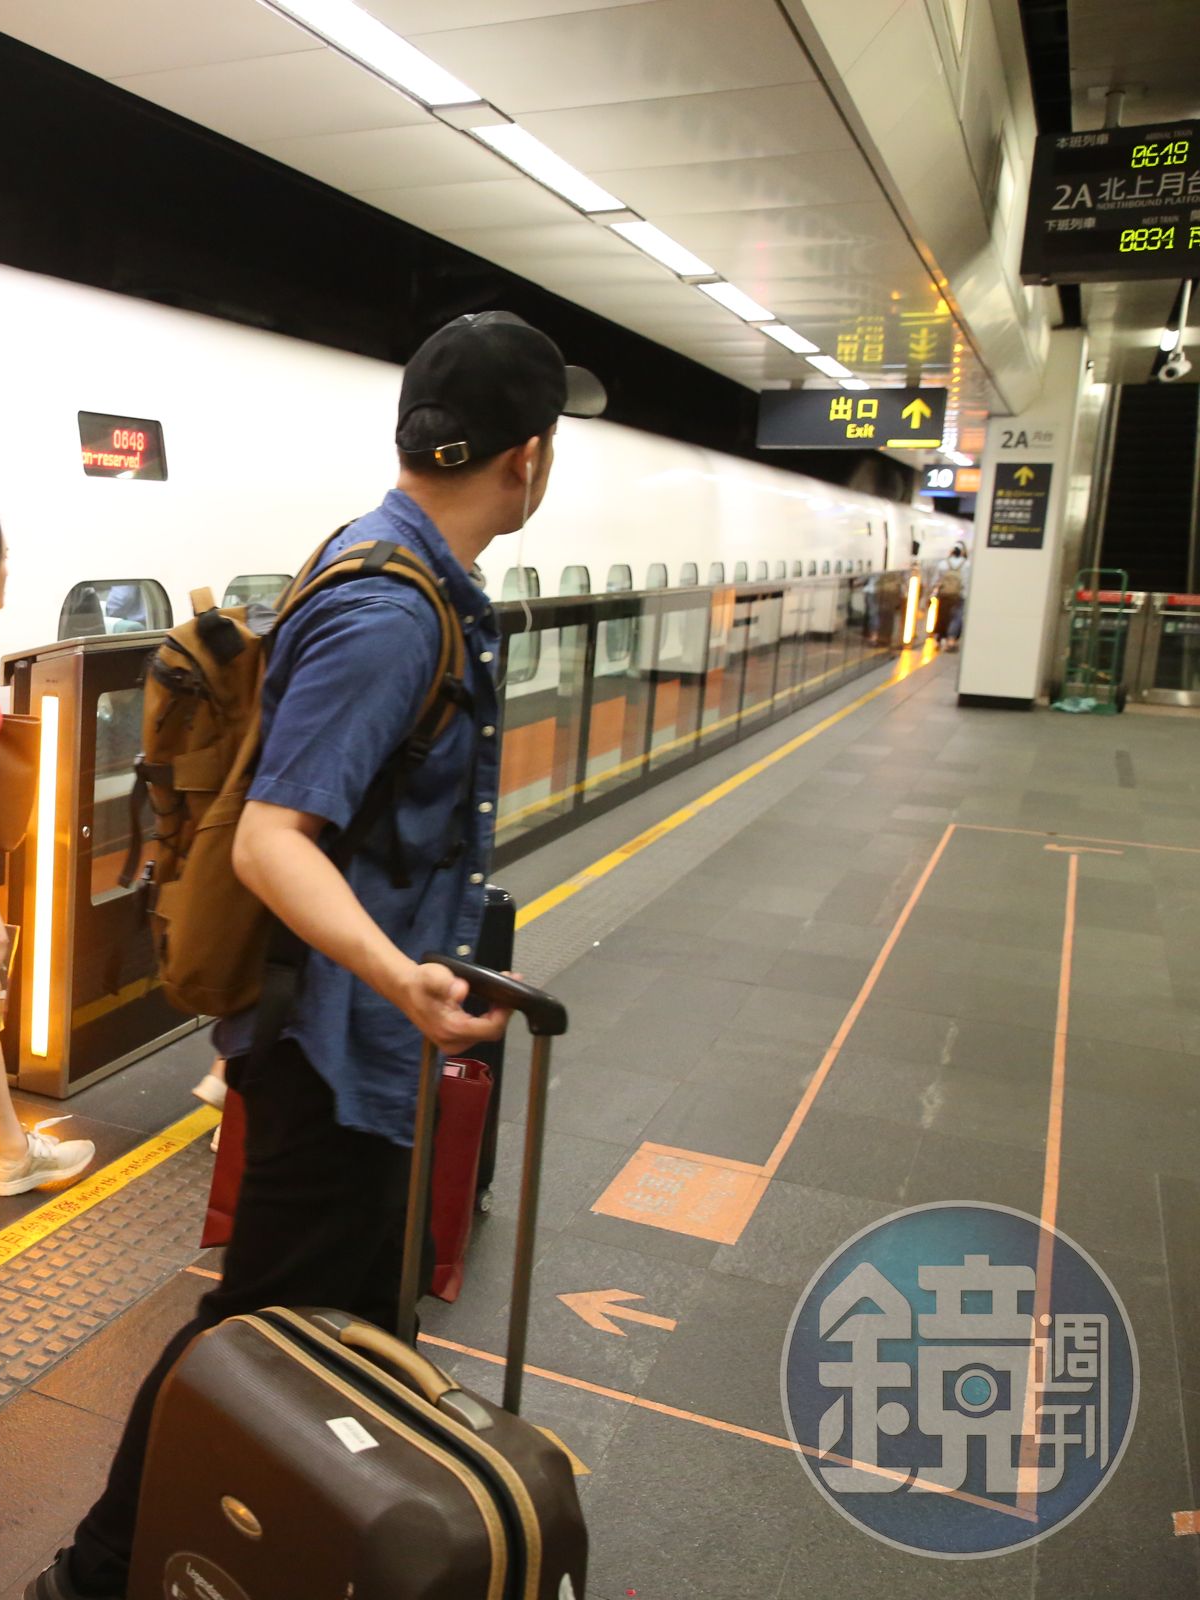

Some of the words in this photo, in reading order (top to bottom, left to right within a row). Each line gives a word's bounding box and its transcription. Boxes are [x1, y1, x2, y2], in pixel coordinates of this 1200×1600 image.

[1051, 183, 1093, 210] 2A
[829, 396, 879, 421] 出口
[846, 423, 875, 438] Exit
[1001, 430, 1029, 449] 2A
[927, 468, 954, 488] 10
